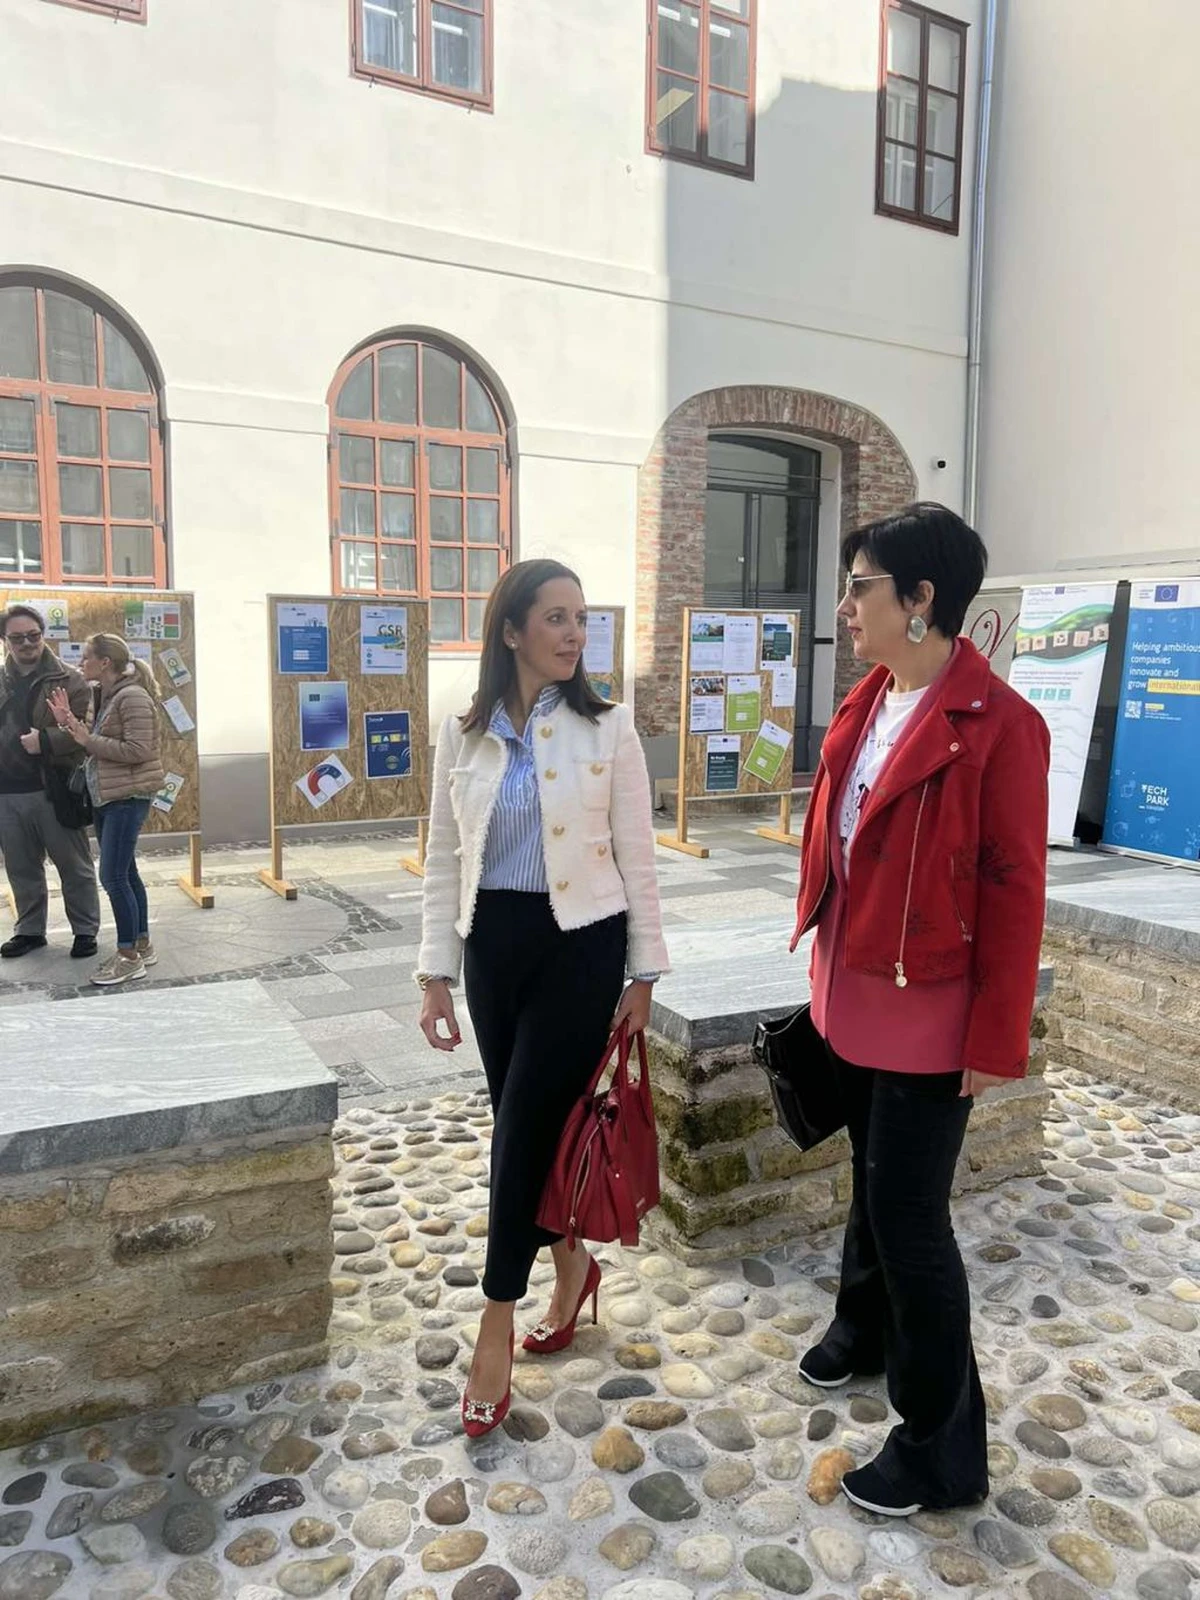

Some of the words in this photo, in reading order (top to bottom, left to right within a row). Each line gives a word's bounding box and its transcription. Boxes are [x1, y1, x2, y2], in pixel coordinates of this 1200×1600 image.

[379, 624, 403, 637] CSR
[1132, 642, 1161, 654] Helping
[1130, 656, 1171, 665] companies
[1129, 668, 1162, 677] innovate
[1163, 668, 1180, 677] and
[1127, 681, 1147, 690] grow
[1141, 784, 1168, 796] TECH
[1146, 795, 1170, 806] PARK
